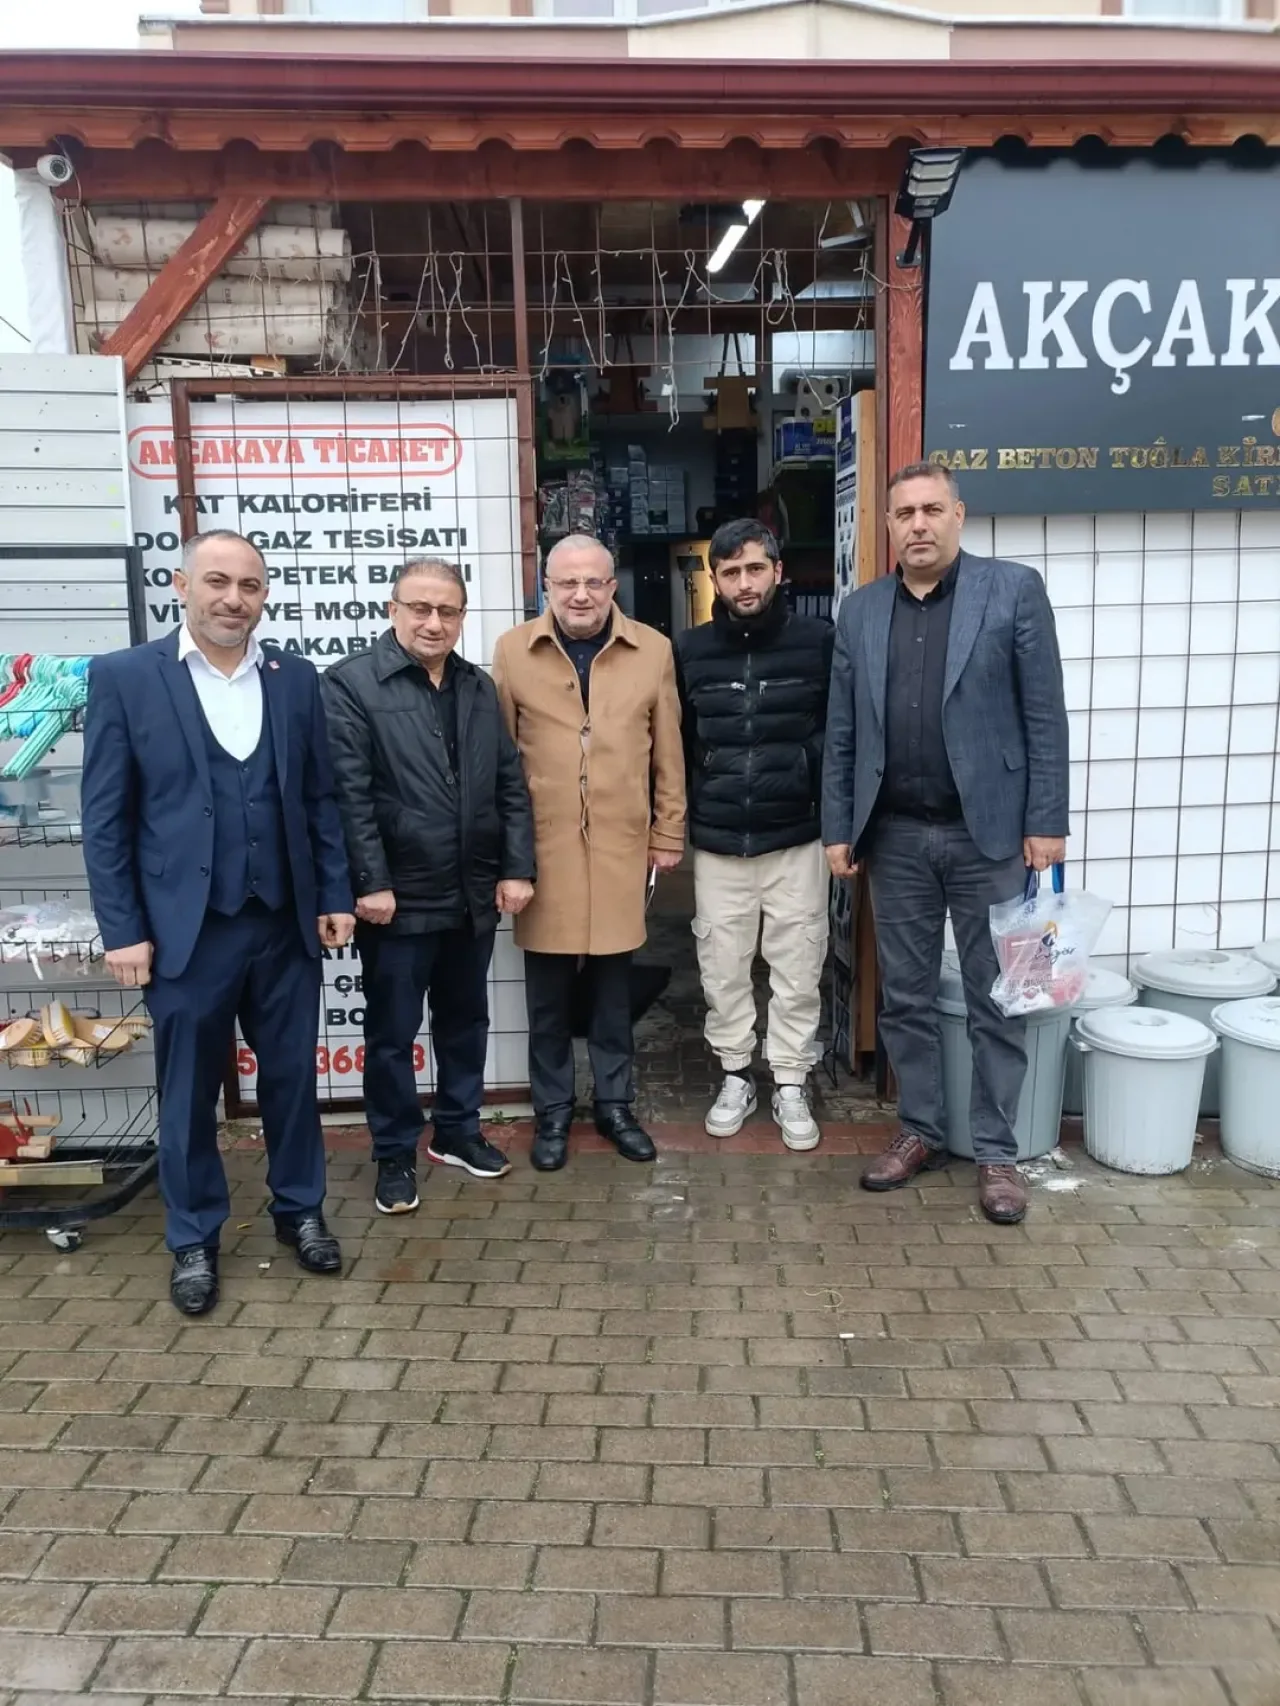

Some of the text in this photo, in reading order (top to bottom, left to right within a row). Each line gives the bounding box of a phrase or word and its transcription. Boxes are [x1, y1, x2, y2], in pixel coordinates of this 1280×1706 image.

[313, 432, 449, 464] TİCARET
[929, 436, 1280, 470] GAZ BETON TUĞLA KİR
[238, 486, 432, 514] KALORİFERİ
[323, 523, 468, 549] TESİSATI
[267, 564, 358, 586] PETEK
